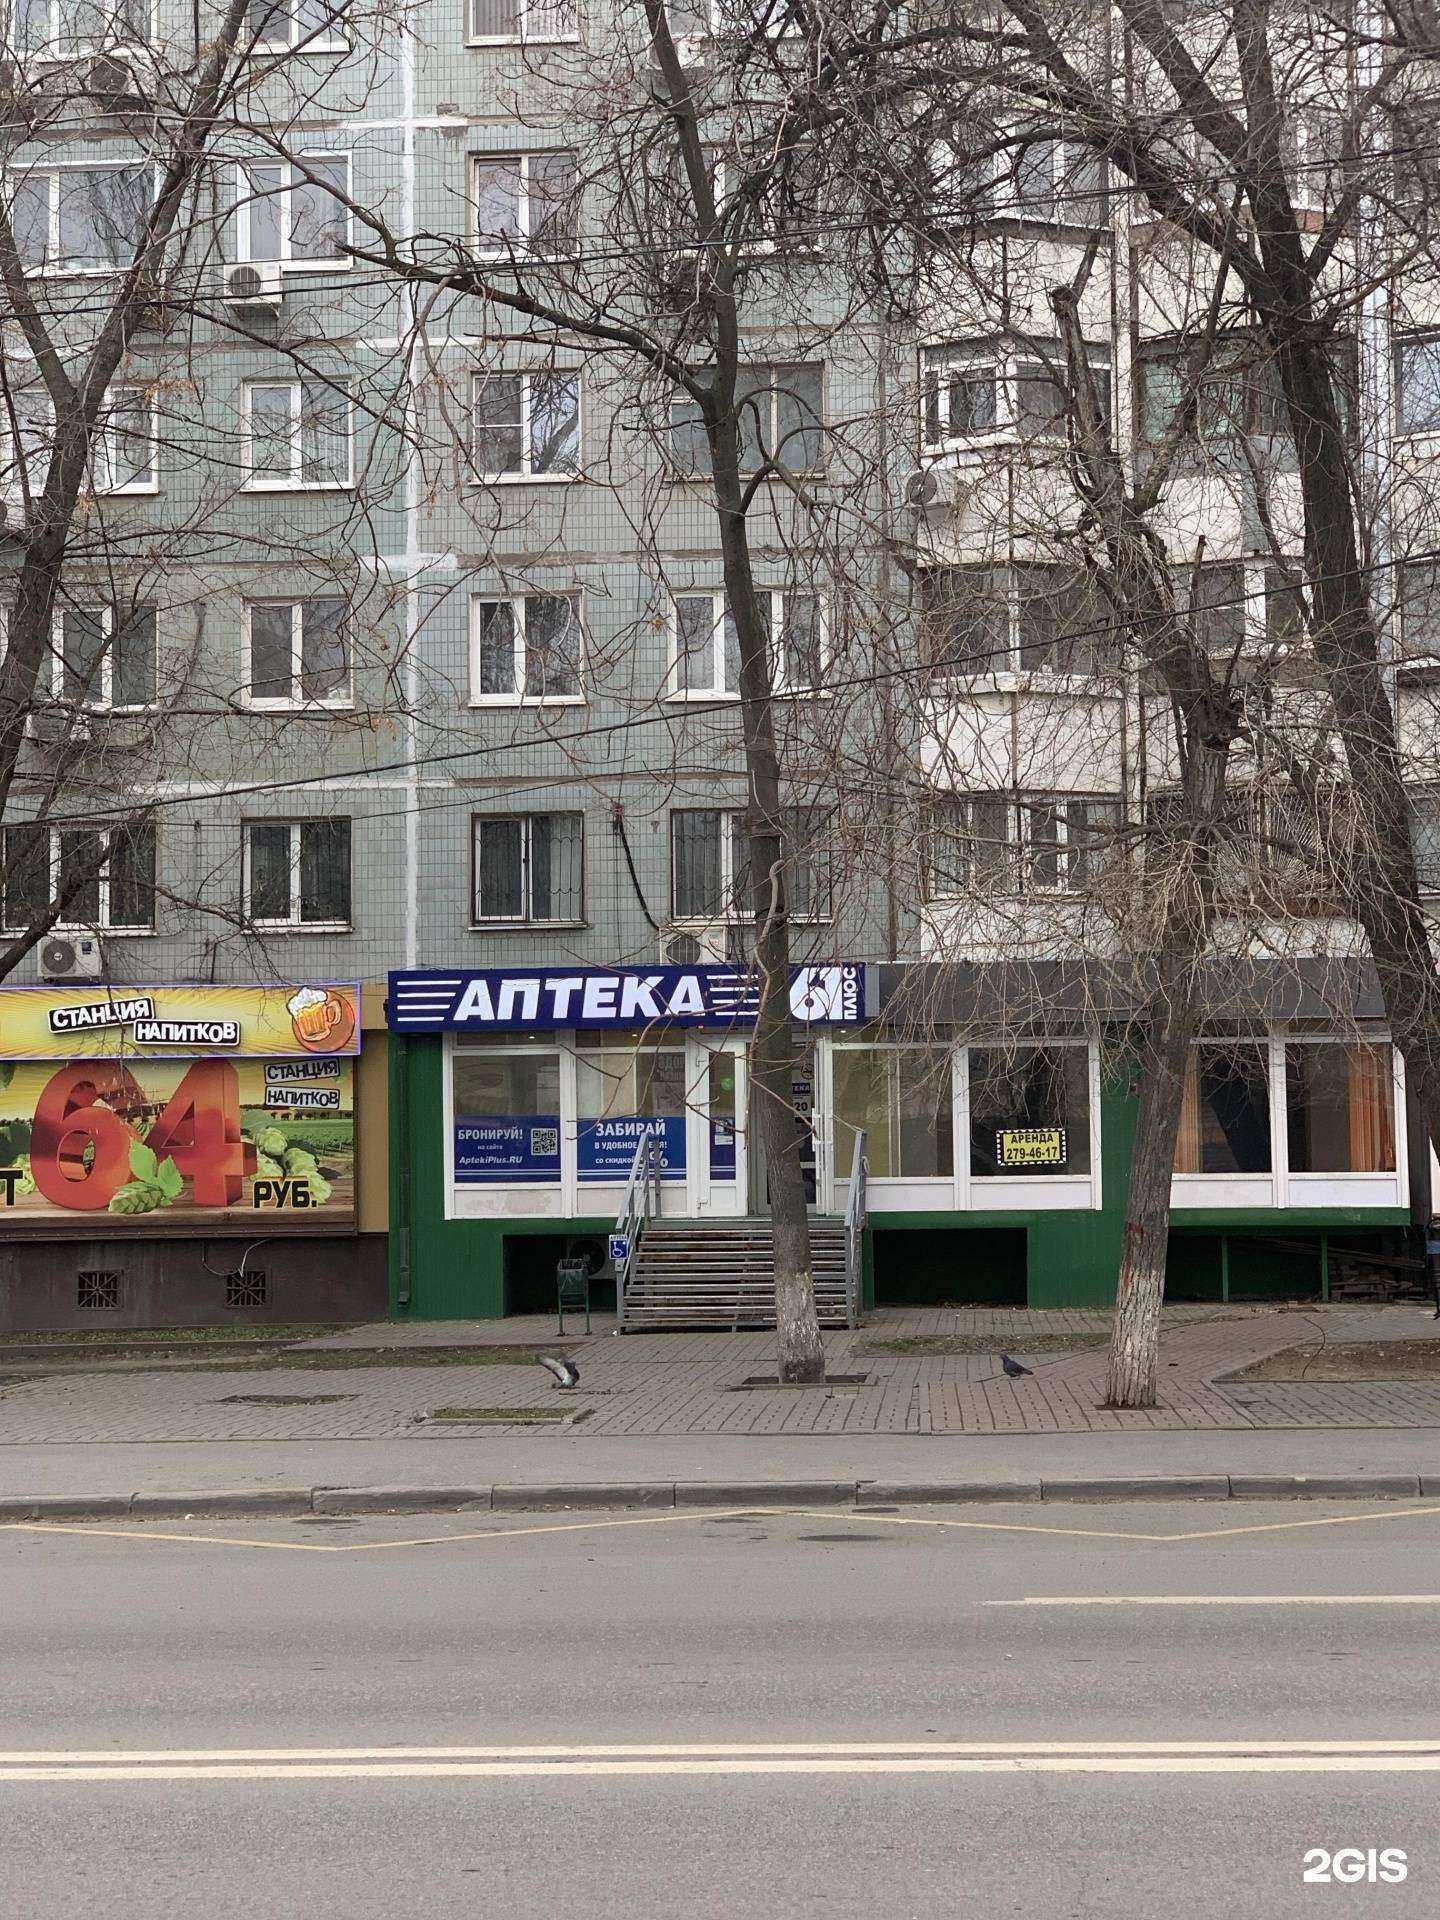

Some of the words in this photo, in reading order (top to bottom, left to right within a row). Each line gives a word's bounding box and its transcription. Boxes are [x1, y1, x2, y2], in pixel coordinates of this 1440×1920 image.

[453, 975, 706, 1021] АПТЕКА
[843, 966, 857, 1020] ПЛЮС
[51, 1000, 150, 1028] СТАНЦИЯ
[137, 1021, 236, 1042] НАПИТКОВ
[266, 1058, 339, 1081] СТАНЦИЯ
[267, 1088, 339, 1106] НАПИТКОВ
[458, 1126, 523, 1140] БРОНИРУЙ!
[595, 1118, 666, 1137] ЗАБИРАЙ
[601, 1141, 638, 1151] УДОБНОЕ
[1010, 1133, 1054, 1144] АРЕНДА
[1006, 1146, 1058, 1160] 279-46-17
[253, 1179, 318, 1209] РУБ.
